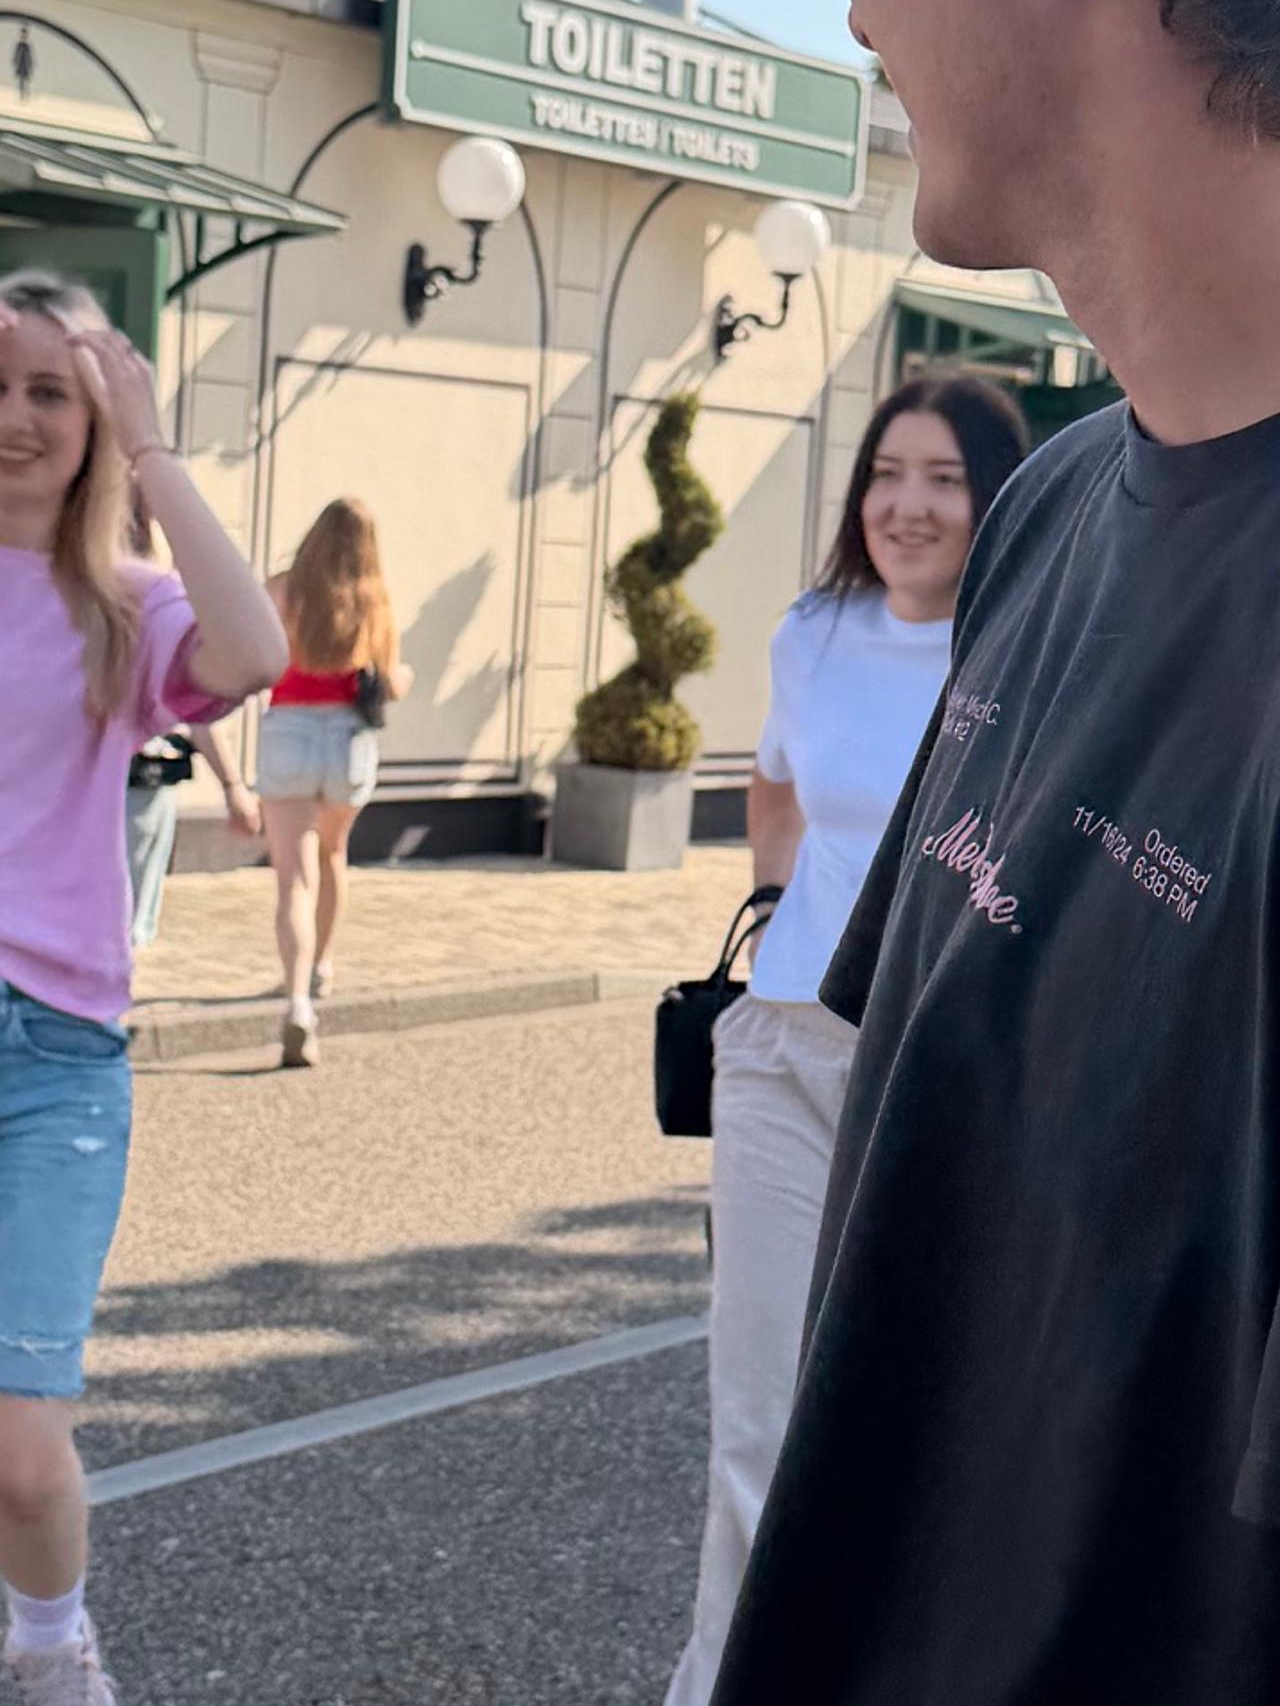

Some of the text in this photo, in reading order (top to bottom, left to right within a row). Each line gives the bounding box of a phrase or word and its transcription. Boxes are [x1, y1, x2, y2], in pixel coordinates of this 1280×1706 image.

[521, 0, 777, 119] TOILETTEN
[1132, 856, 1168, 897] 6:38
[1166, 883, 1198, 922] PM
[1144, 828, 1212, 894] Ordered
